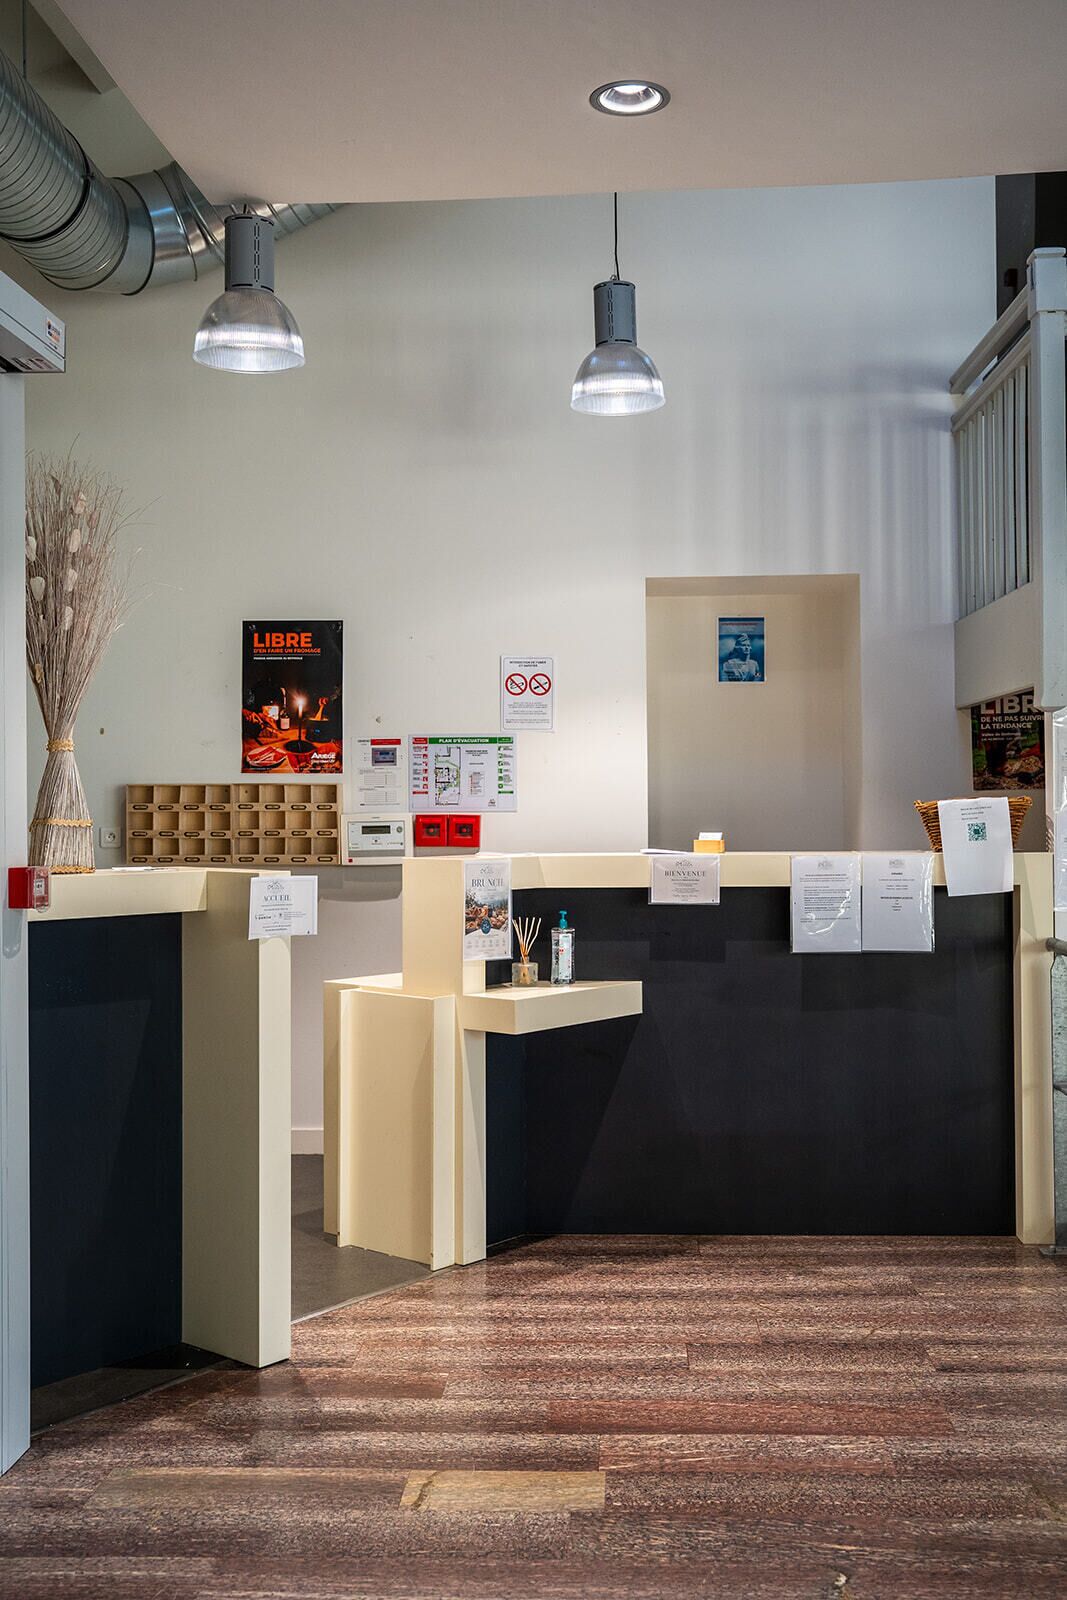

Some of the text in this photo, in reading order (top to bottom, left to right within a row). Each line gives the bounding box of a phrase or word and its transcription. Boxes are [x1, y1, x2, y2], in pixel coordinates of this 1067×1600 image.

[253, 632, 312, 647] LIBRE
[981, 695, 1040, 713] LIBR
[471, 879, 504, 887] BRUNCH
